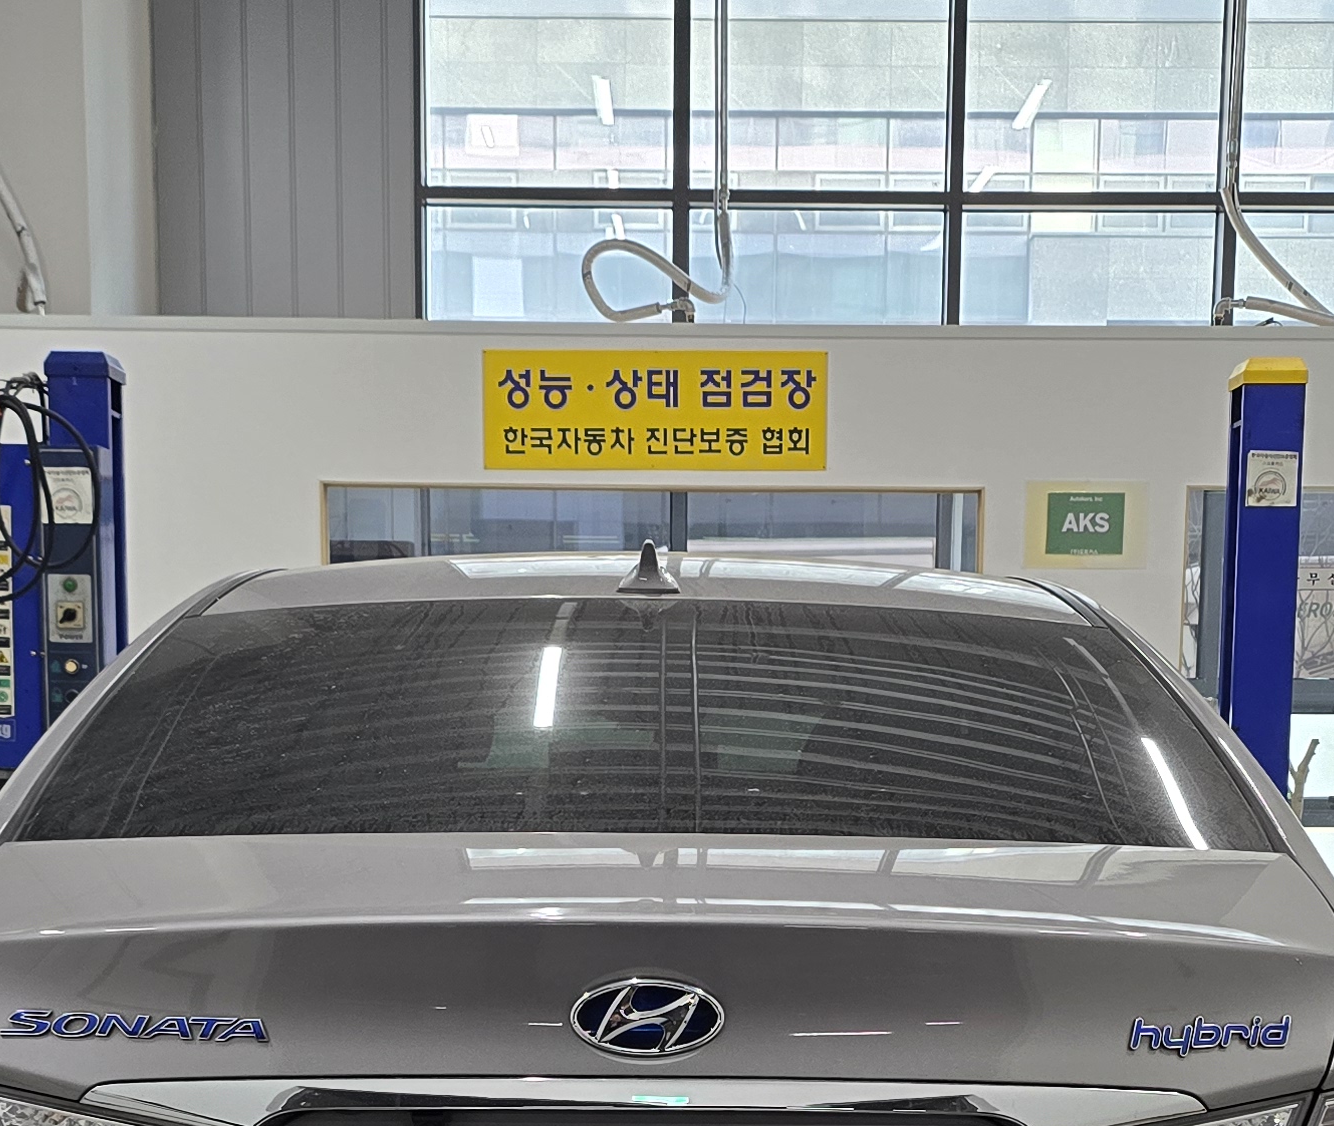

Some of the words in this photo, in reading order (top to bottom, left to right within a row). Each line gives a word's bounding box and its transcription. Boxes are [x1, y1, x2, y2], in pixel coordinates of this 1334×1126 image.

[699, 369, 817, 409] 점검장
[503, 426, 635, 455] 한국자동차
[646, 426, 748, 456] 진단보증
[761, 426, 810, 455] 협회
[1061, 512, 1110, 533] AKS
[0, 1009, 269, 1042] SONATA
[1130, 1014, 1292, 1057] hybrid
